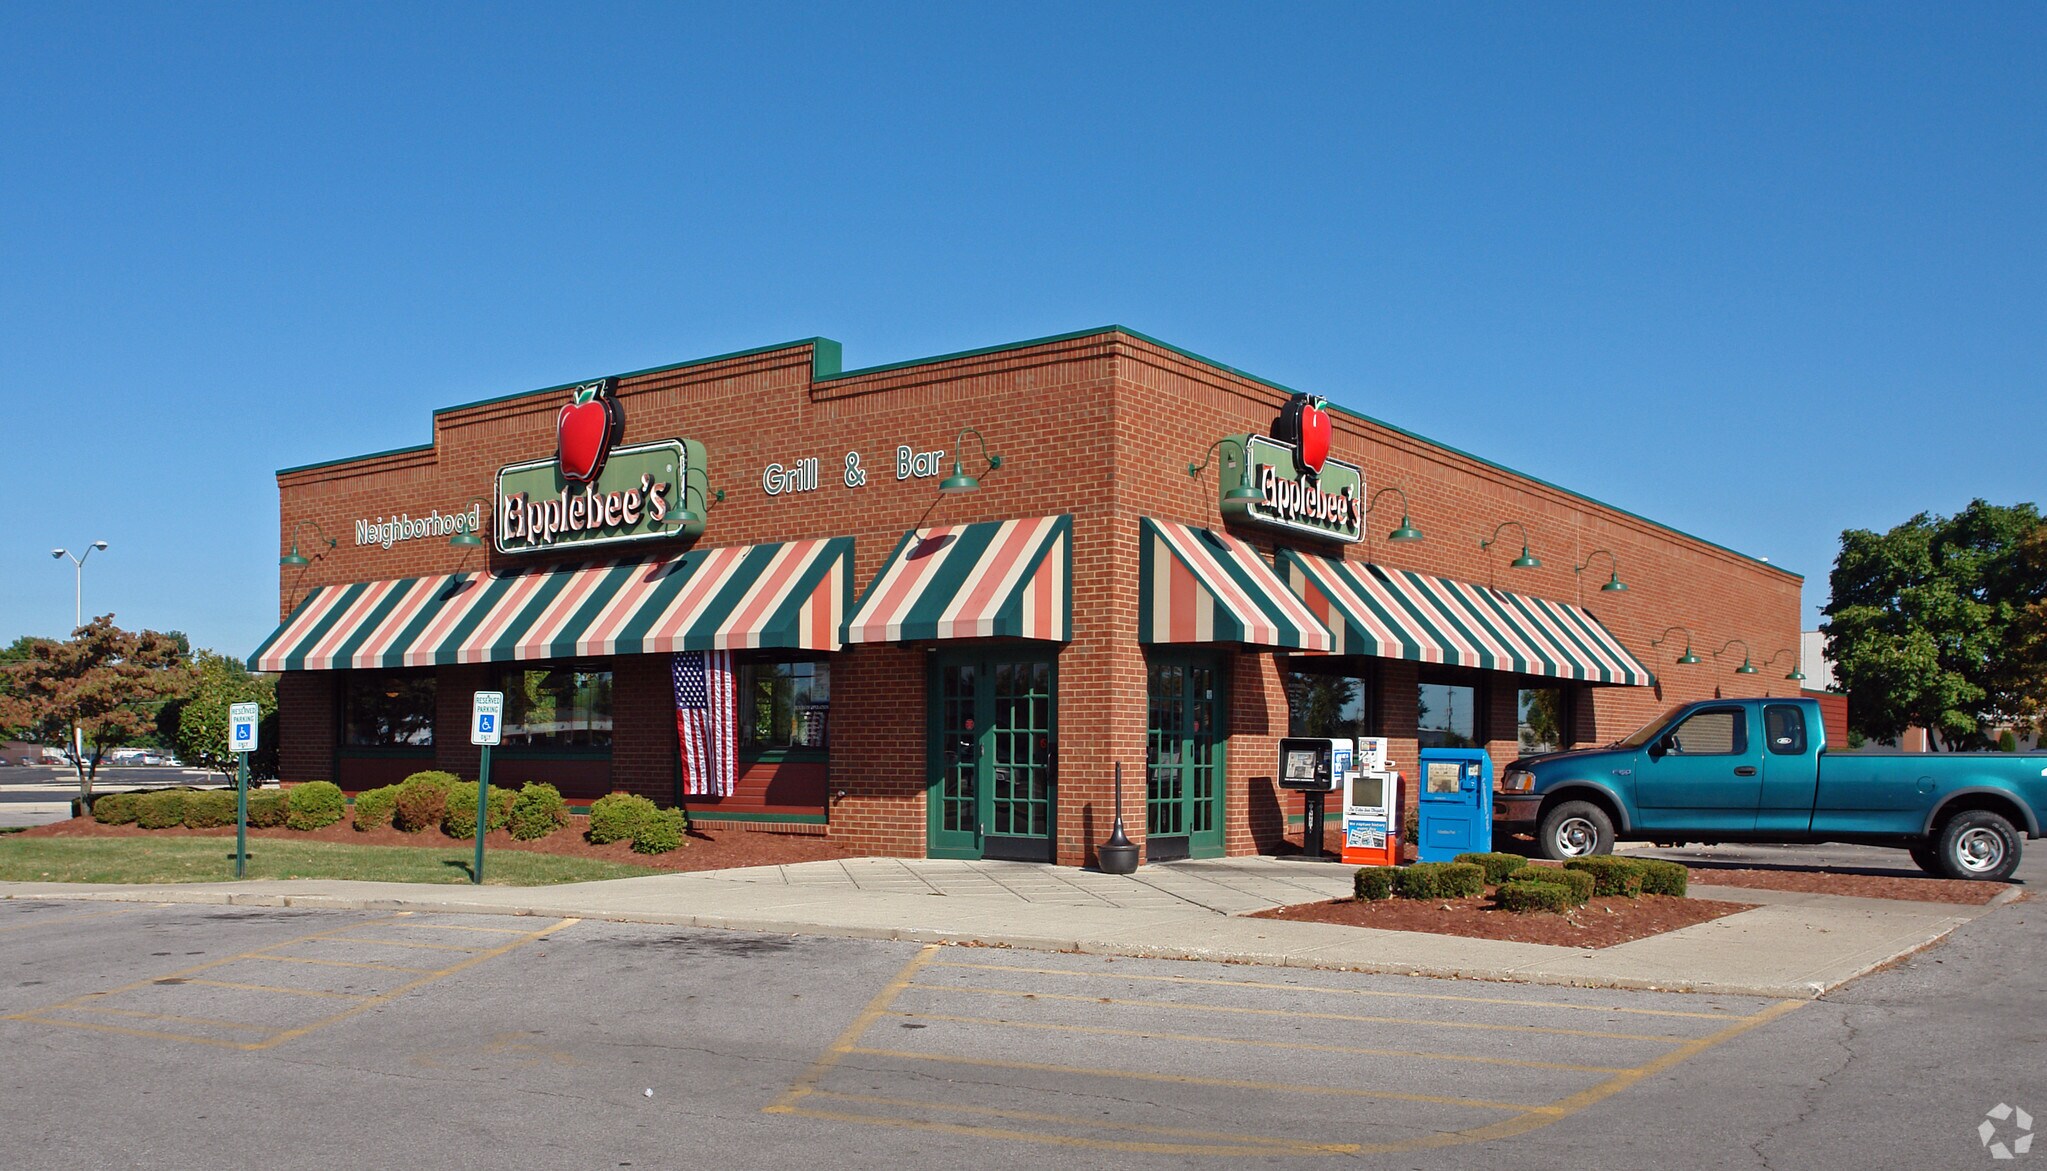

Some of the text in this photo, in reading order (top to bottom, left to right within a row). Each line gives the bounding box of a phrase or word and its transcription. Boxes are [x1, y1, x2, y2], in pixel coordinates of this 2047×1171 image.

[763, 445, 945, 496] Grill & Bar
[1261, 464, 1360, 529] Applebee's
[355, 503, 480, 550] Neighborhood
[503, 472, 667, 546] Applebee's
